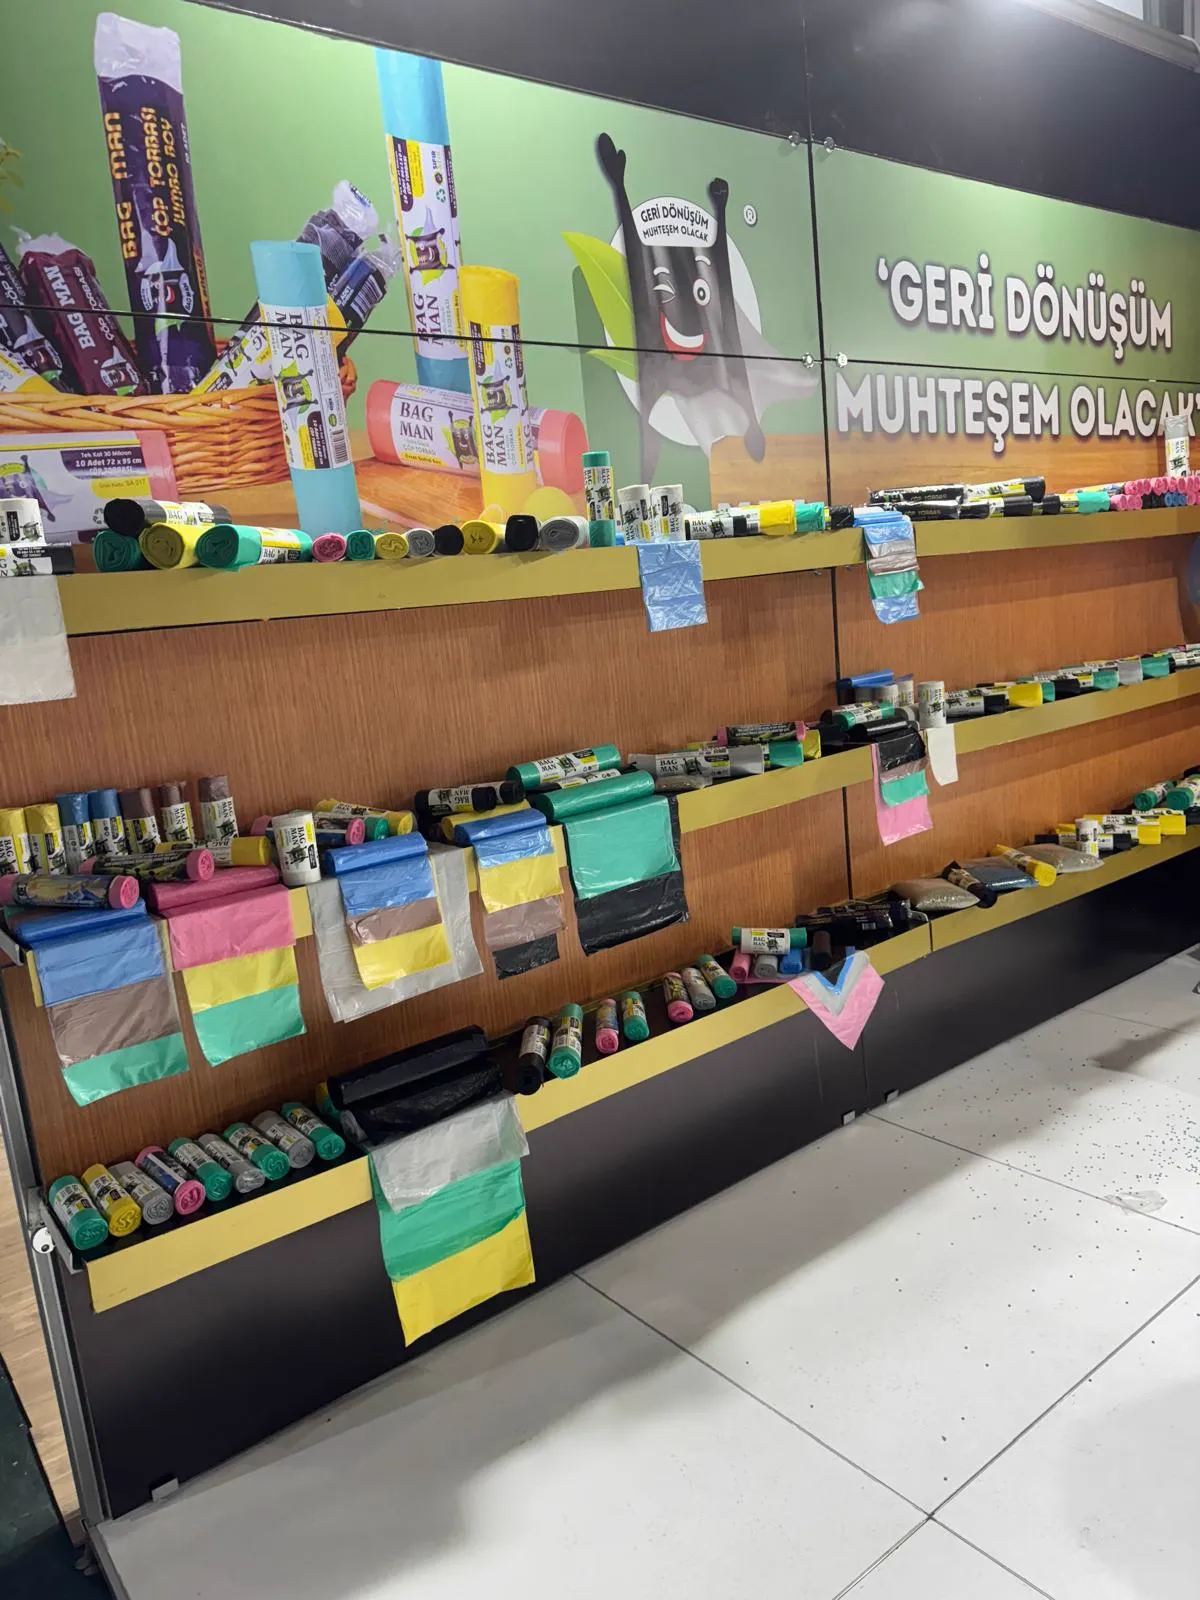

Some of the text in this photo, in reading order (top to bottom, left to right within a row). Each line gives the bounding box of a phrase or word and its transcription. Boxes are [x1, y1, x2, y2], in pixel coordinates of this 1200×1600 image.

[104, 112, 138, 259] BAG MAN
[140, 106, 173, 237] ÇÖP TORBASI
[641, 202, 709, 230] GERİ DÖNÜŞÜM
[643, 224, 708, 242] MUHTEŞEM OLACAK
[44, 266, 96, 349] BAG MAN
[72, 266, 101, 312] TORBASI
[413, 294, 430, 343] BAG
[426, 295, 443, 346] MAN
[1006, 264, 1172, 360] DÖNÜŞÜM
[275, 312, 294, 360] MAN
[289, 312, 309, 360] BAG
[400, 402, 434, 423] BAG
[400, 422, 434, 442] MAN
[836, 371, 1060, 453] MUHTEŞEM
[76, 460, 86, 468] 10
[88, 458, 105, 466] Adet
[483, 424, 496, 466] BAG
[493, 426, 508, 468] MAN
[524, 424, 535, 463] BAG
[168, 510, 182, 520] BAG
[264, 548, 276, 558] BAG
[542, 764, 558, 772] MAN
[173, 808, 182, 826] MAN
[4, 839, 14, 858] BAG
